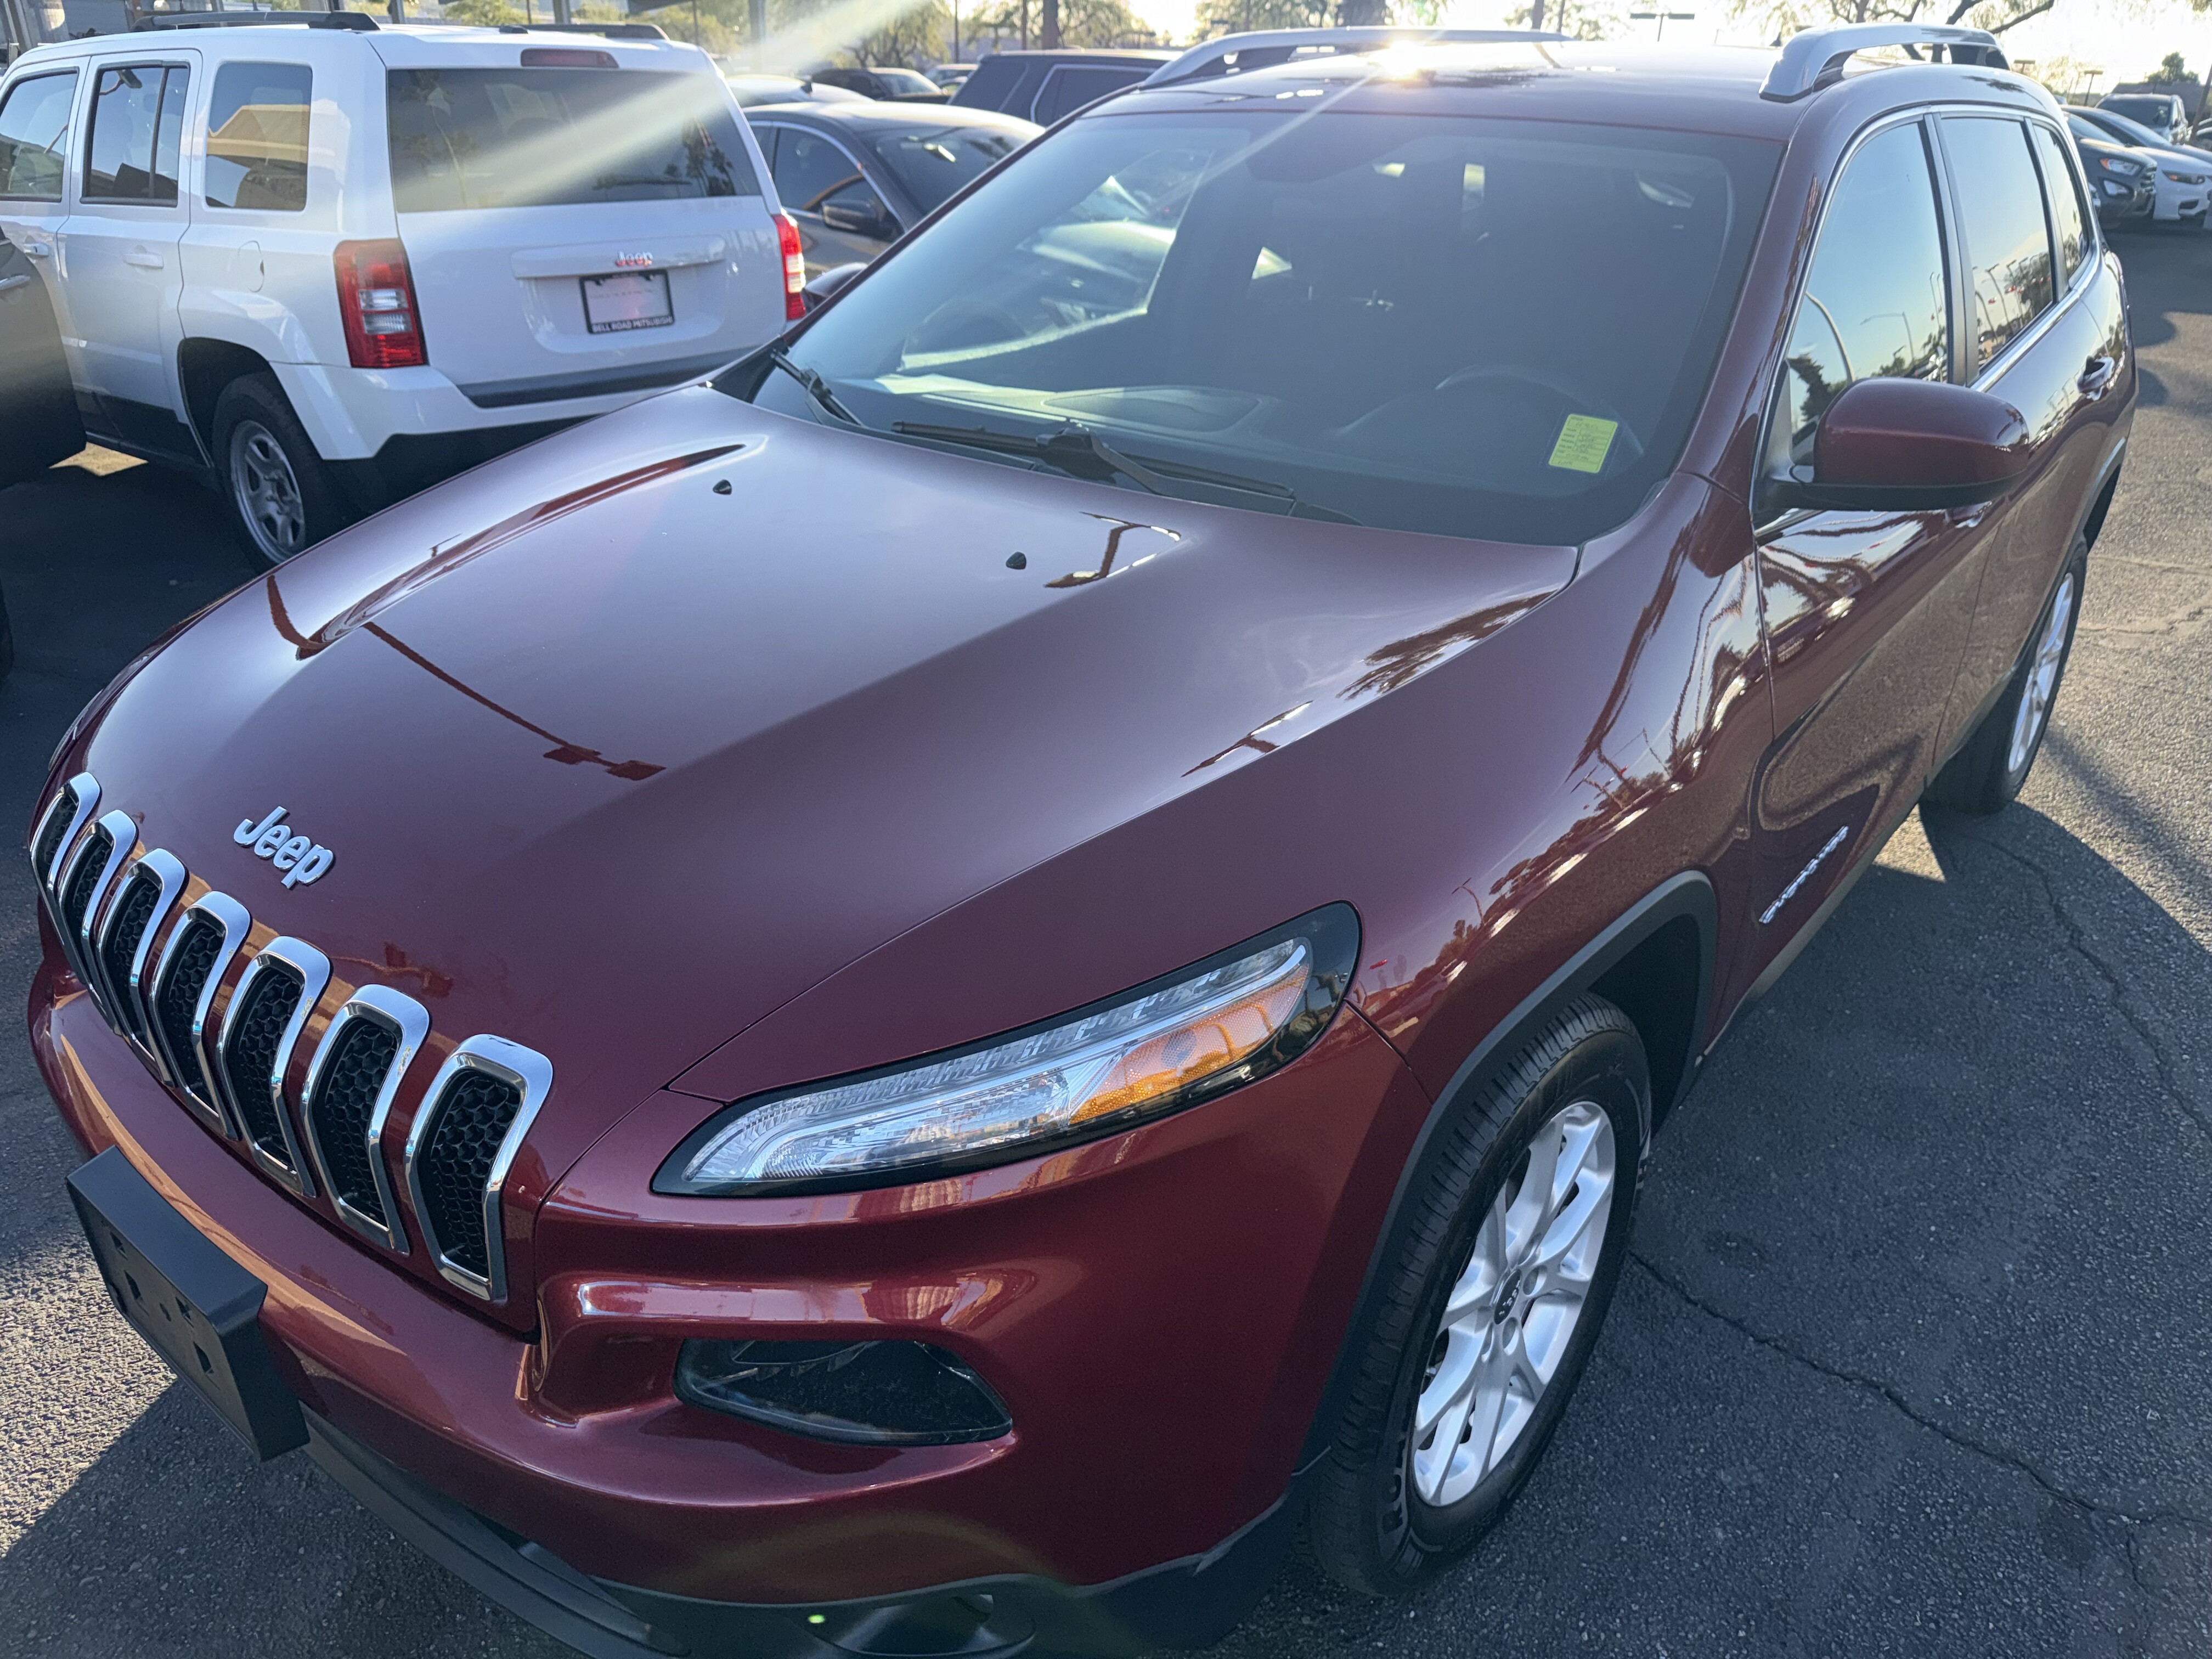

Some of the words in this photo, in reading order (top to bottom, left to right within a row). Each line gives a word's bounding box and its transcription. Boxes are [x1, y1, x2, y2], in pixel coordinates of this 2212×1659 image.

[615, 251, 653, 267] Jeep
[592, 323, 610, 332] BELL
[611, 320, 631, 330] ROAD
[633, 316, 673, 329] MITSUBISHI
[234, 806, 335, 889] Jeep
